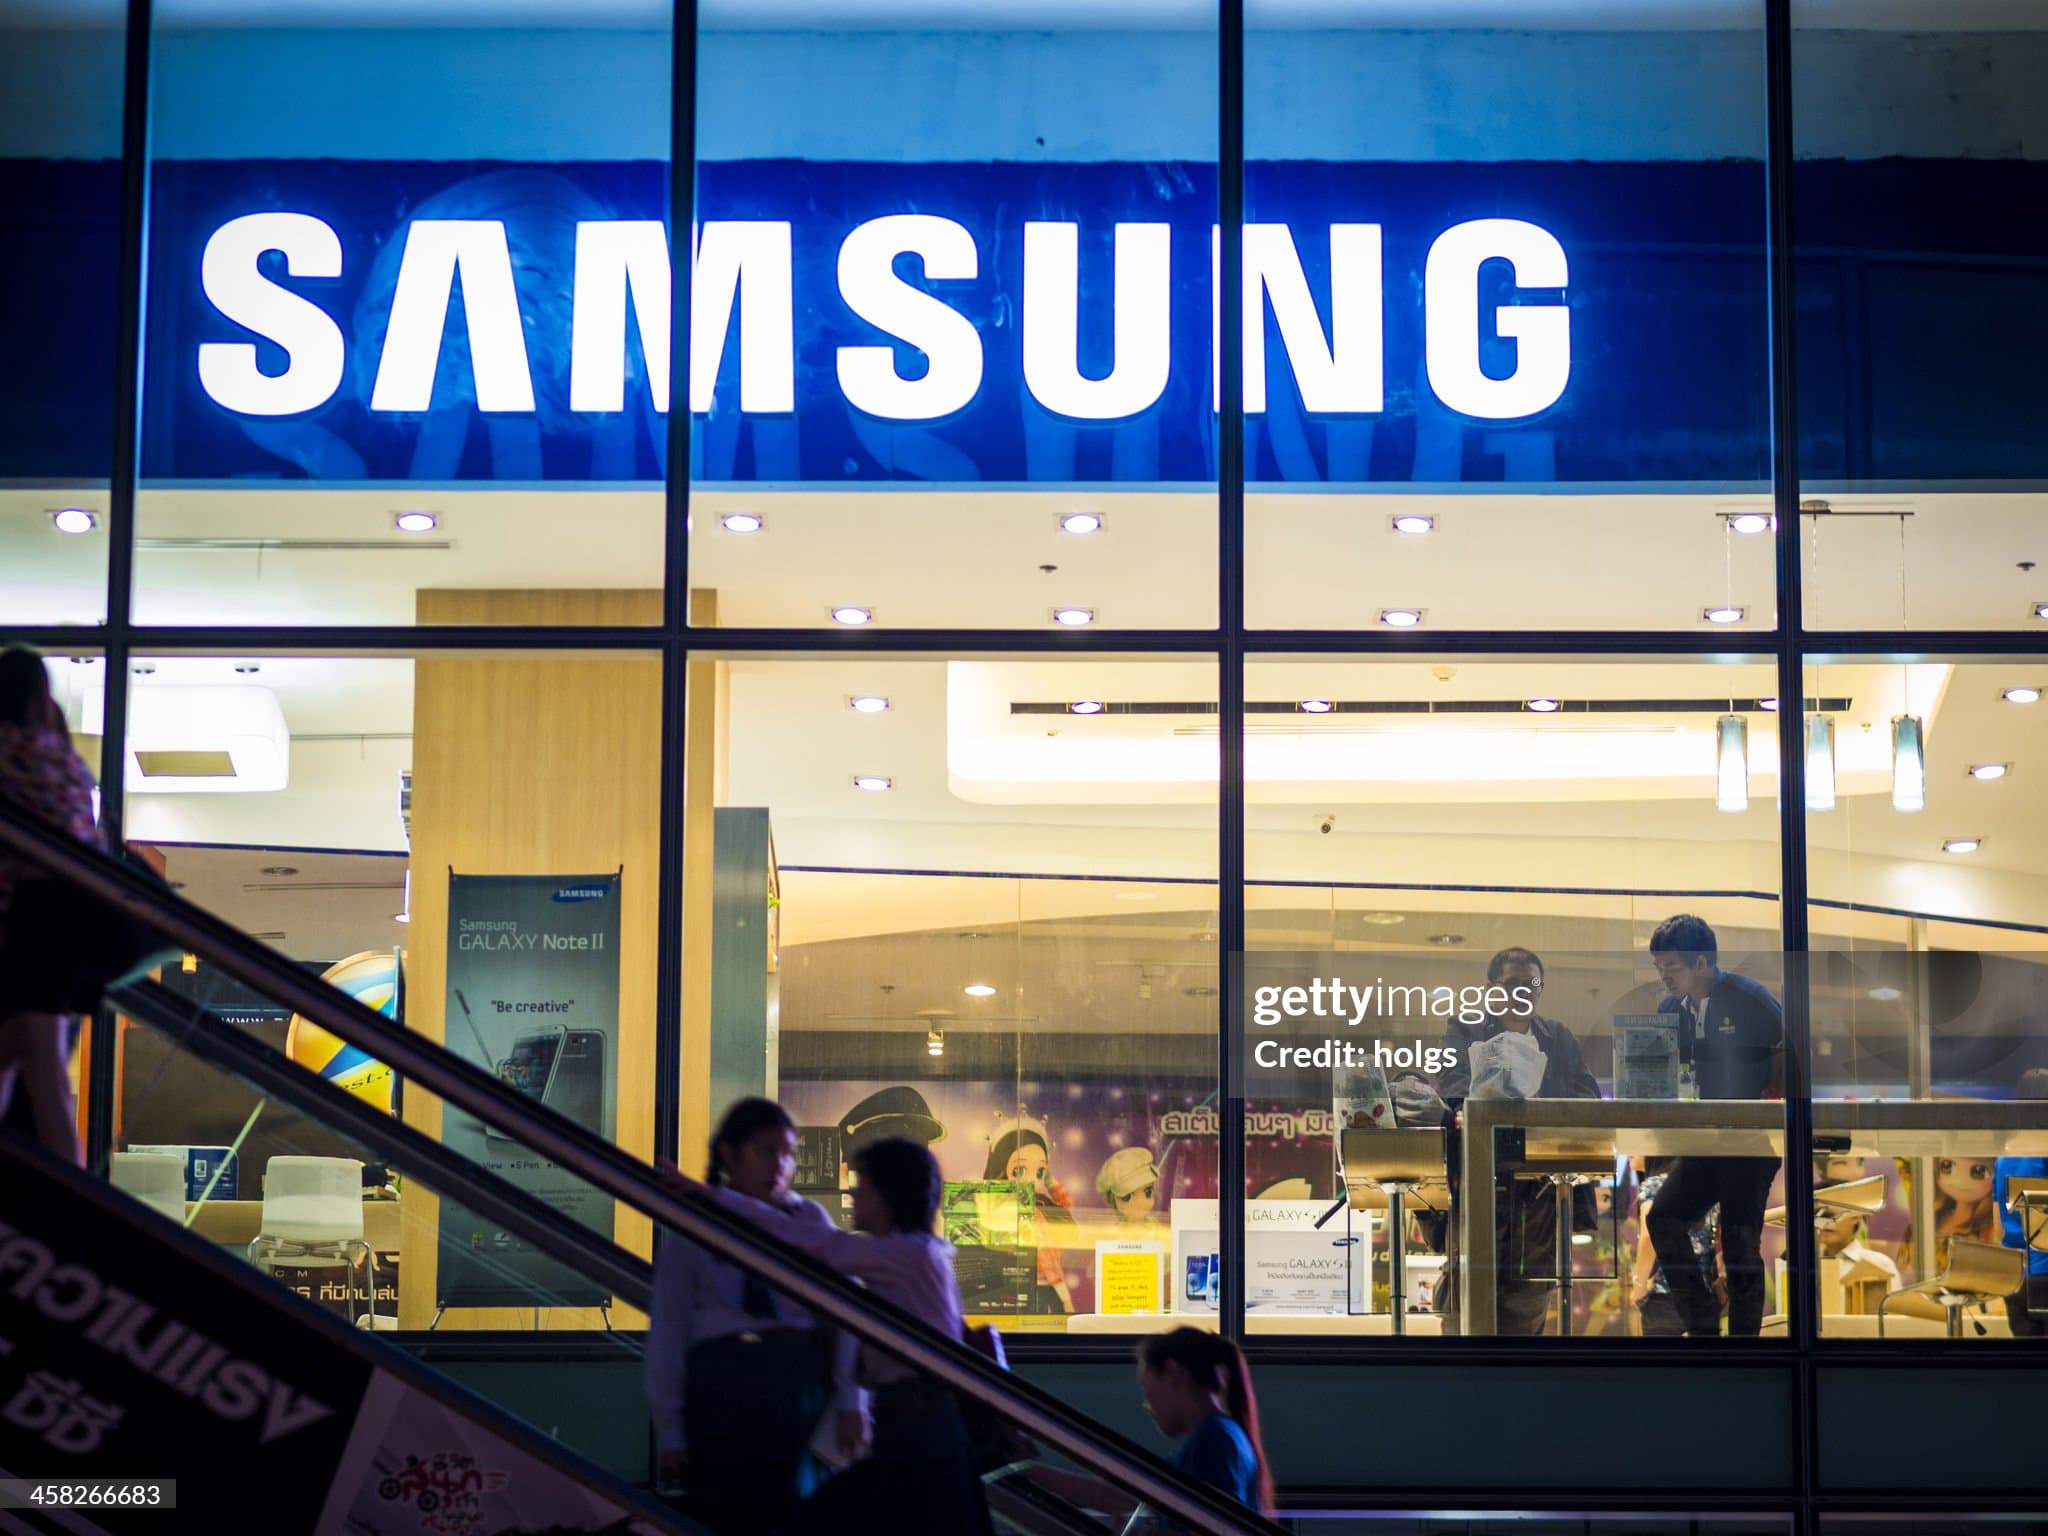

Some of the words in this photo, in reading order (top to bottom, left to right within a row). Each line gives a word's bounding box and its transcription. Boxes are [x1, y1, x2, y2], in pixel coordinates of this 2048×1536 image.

[198, 211, 1572, 421] SAMSUNG
[559, 889, 604, 898] SAMSUNG
[459, 918, 517, 935] Samsung
[459, 933, 538, 950] GALAXY
[543, 933, 588, 950] Note
[592, 933, 604, 950] II
[1252, 1209, 1301, 1222] GALAXY
[1289, 1258, 1331, 1268] GALAXY
